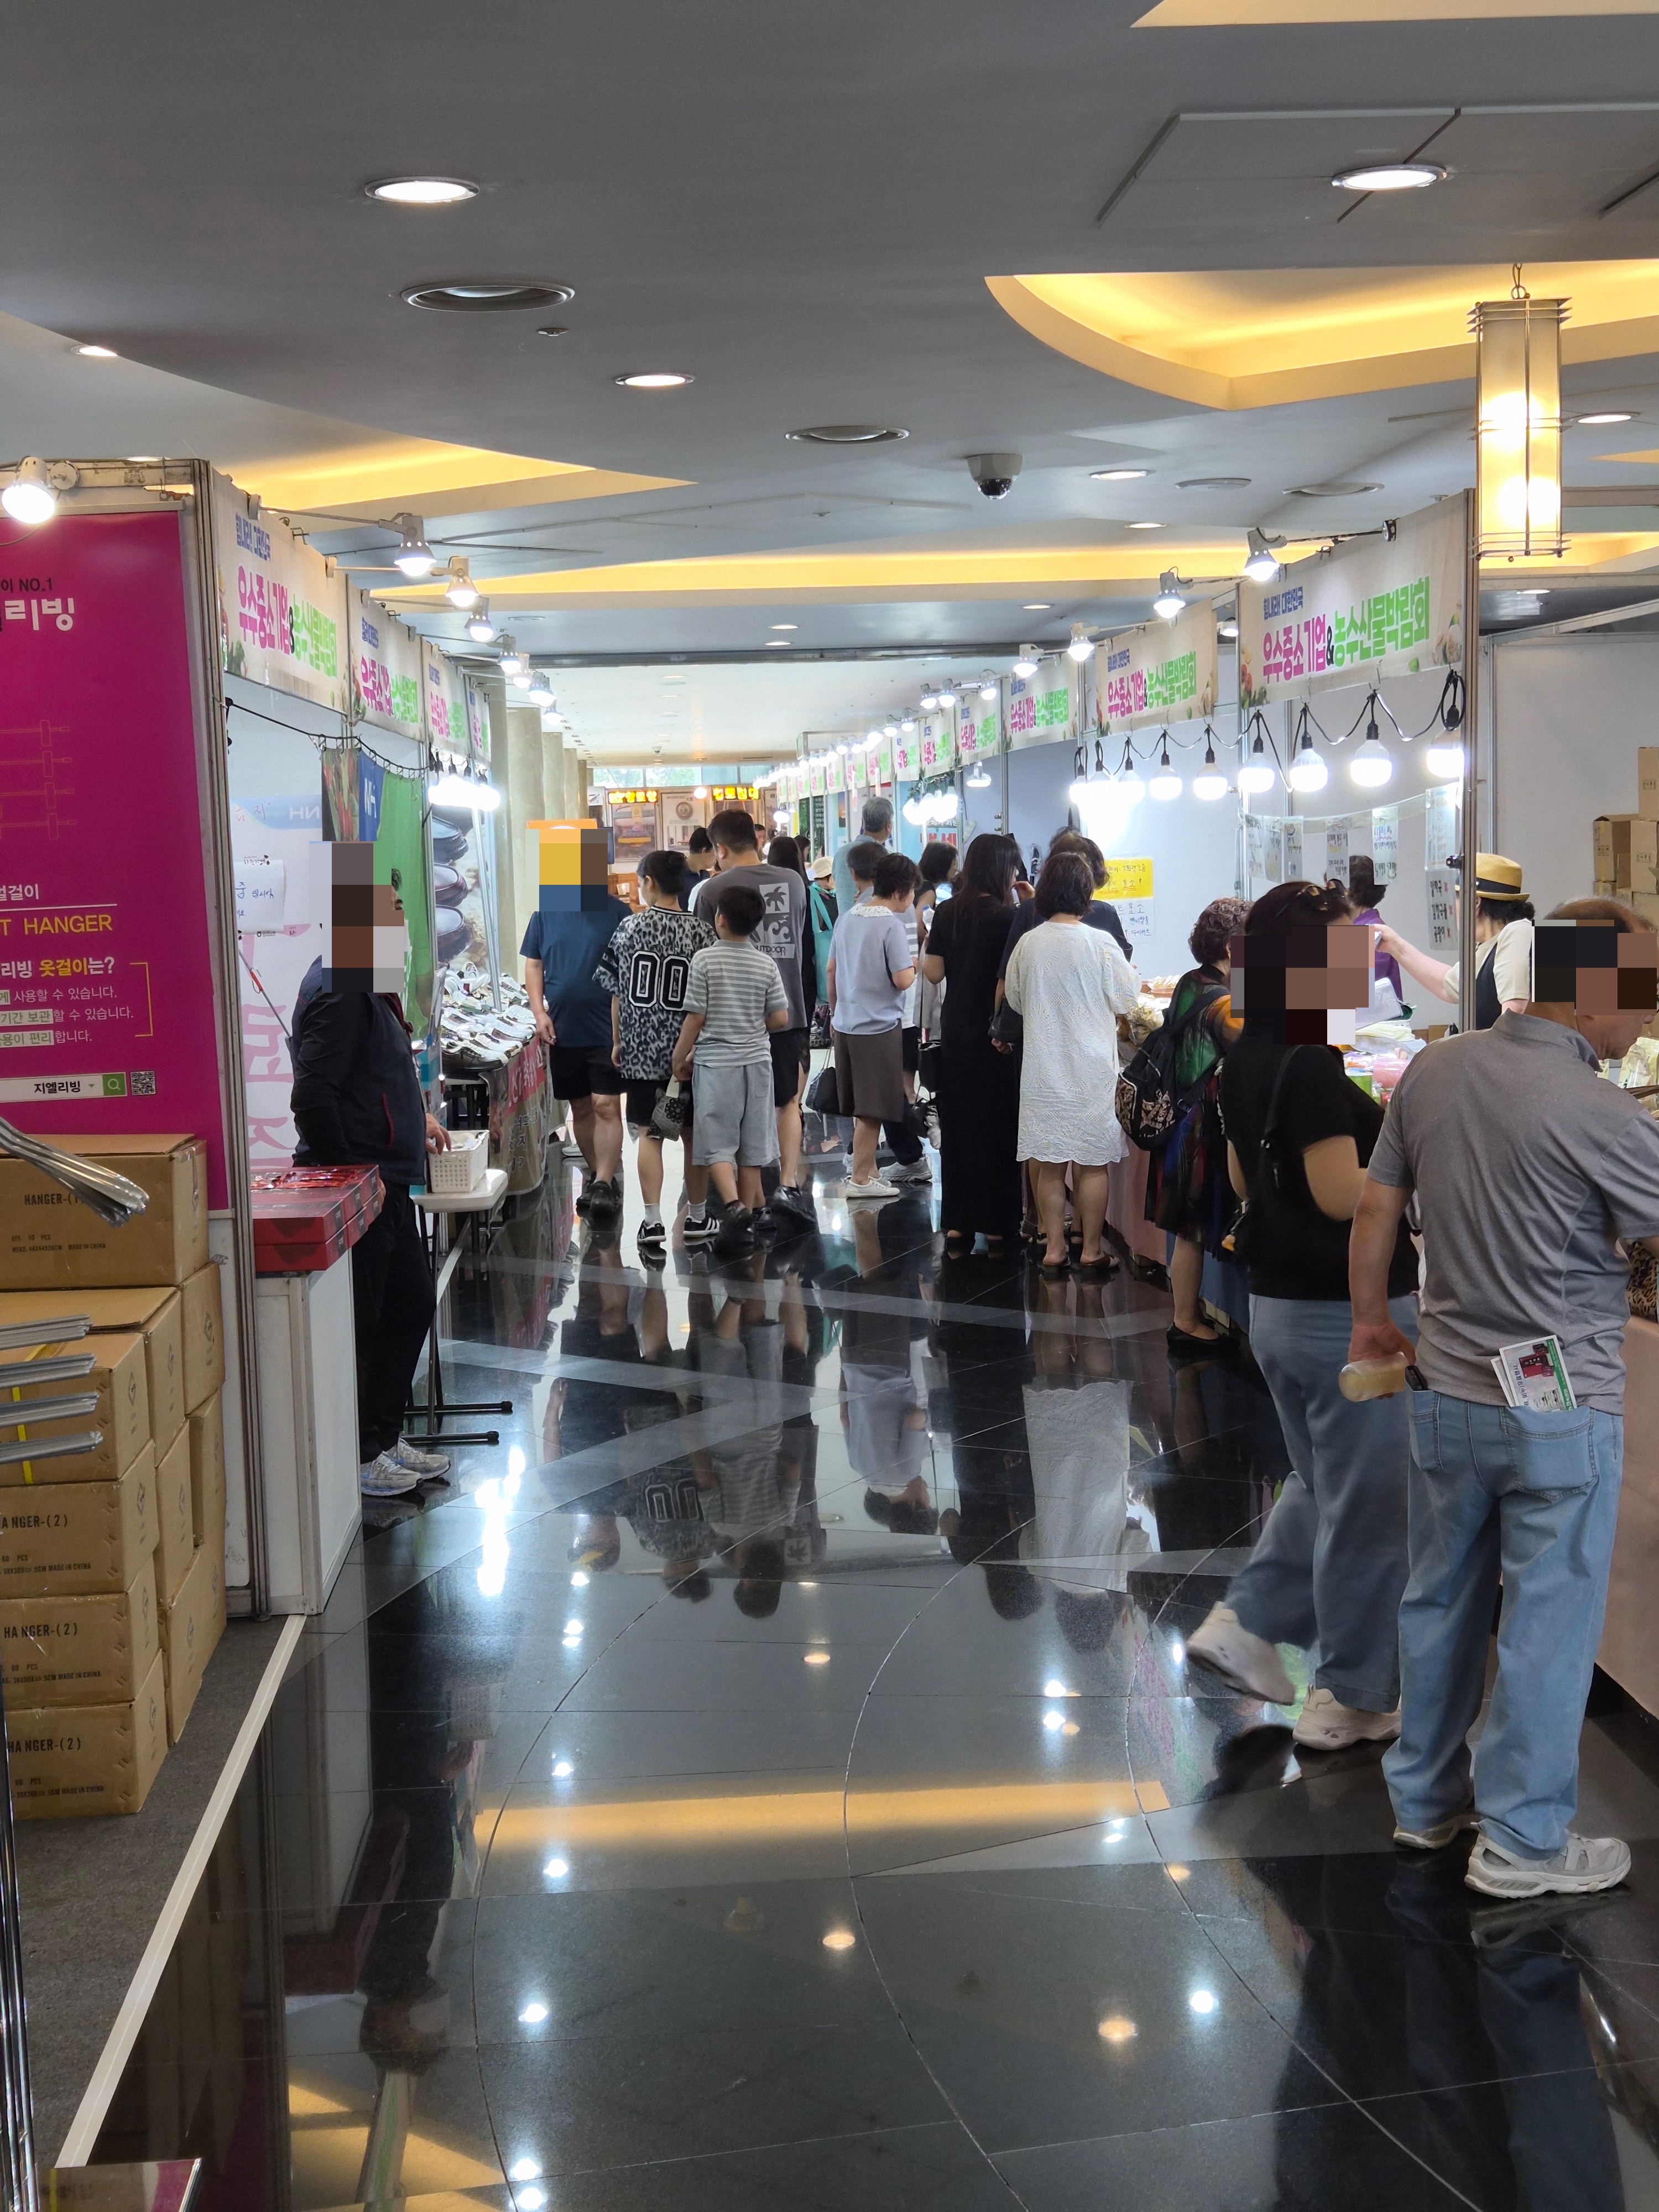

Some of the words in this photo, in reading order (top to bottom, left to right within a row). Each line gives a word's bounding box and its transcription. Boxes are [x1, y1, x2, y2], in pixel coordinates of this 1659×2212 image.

[19, 577, 53, 592] NO.1
[24, 914, 113, 935] HANGER
[39, 956, 115, 978] 옷걸이는?
[14, 989, 48, 1003] 사용할
[53, 990, 64, 1001] 수
[68, 986, 117, 1000] 있습니다.
[69, 1009, 80, 1021] 수
[85, 1006, 134, 1021] 있습니다.
[0, 1033, 24, 1046] 용이
[34, 1081, 81, 1094] 지엘리빙
